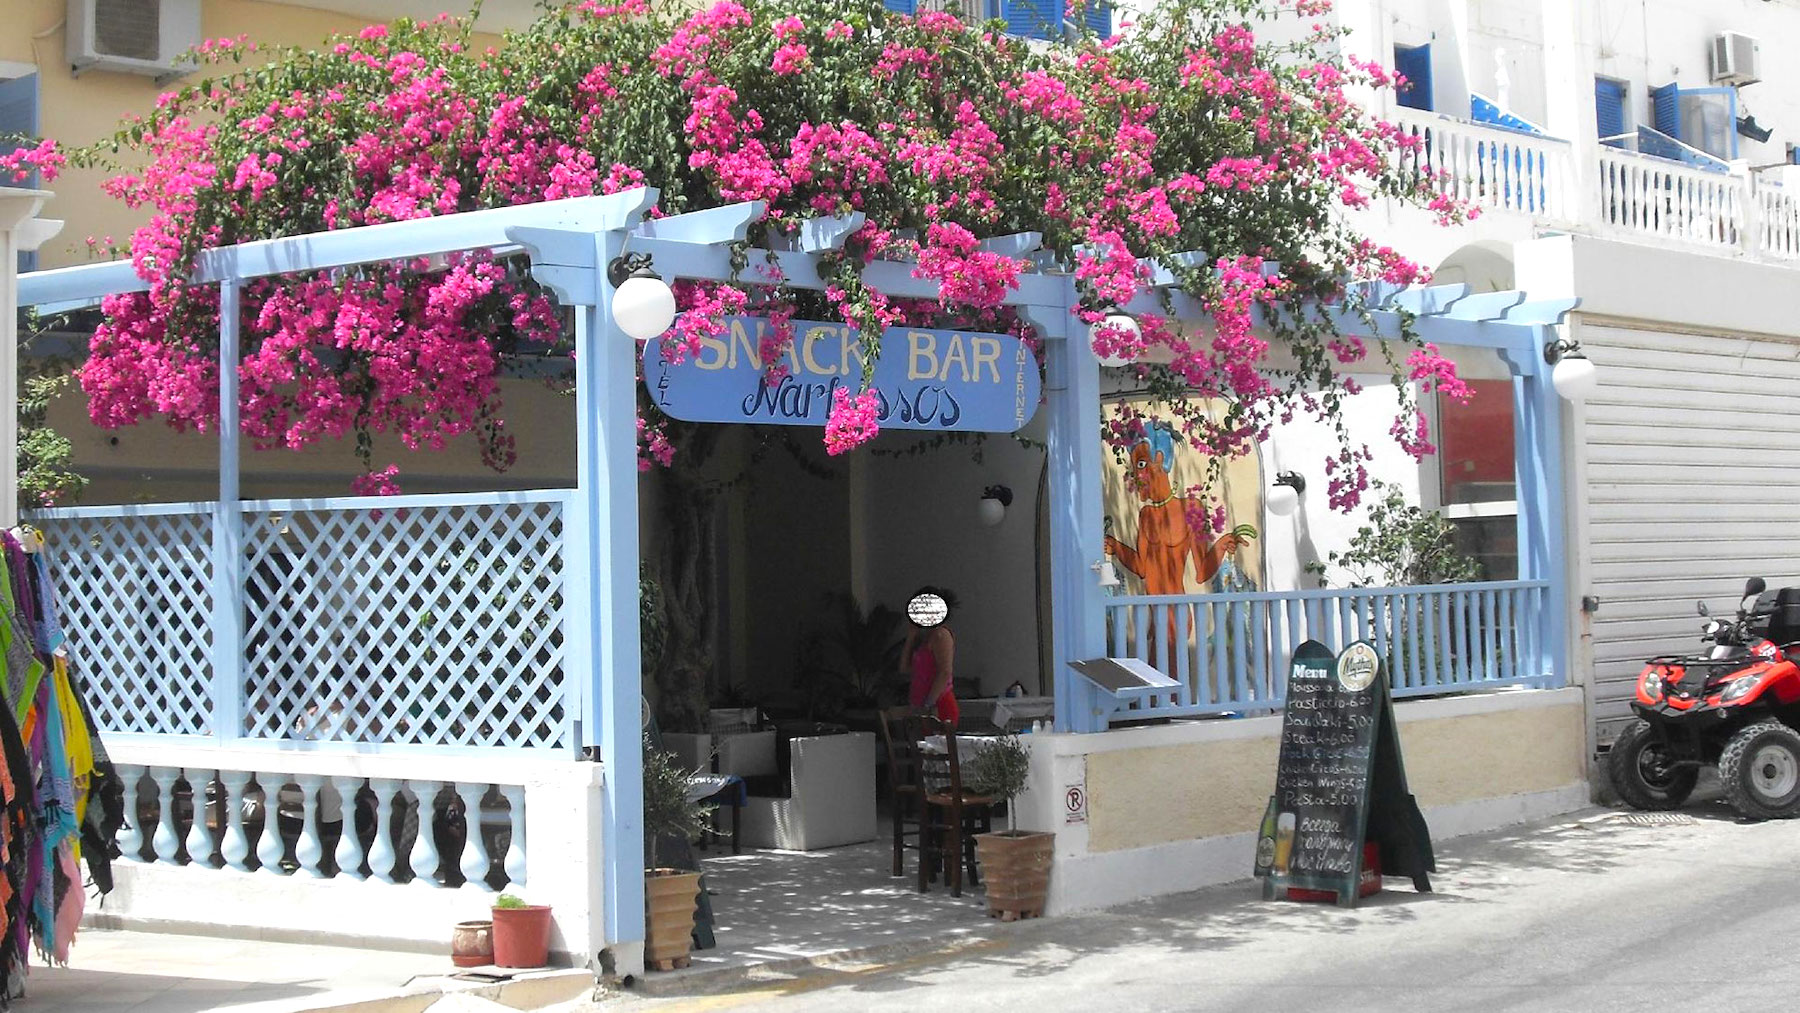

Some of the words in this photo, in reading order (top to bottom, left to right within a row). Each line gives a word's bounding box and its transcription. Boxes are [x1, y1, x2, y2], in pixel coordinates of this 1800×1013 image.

[908, 331, 1001, 383] BAR
[1015, 338, 1027, 427] INTERNET
[742, 375, 961, 427] Narssos
[1292, 664, 1328, 678] Menu
